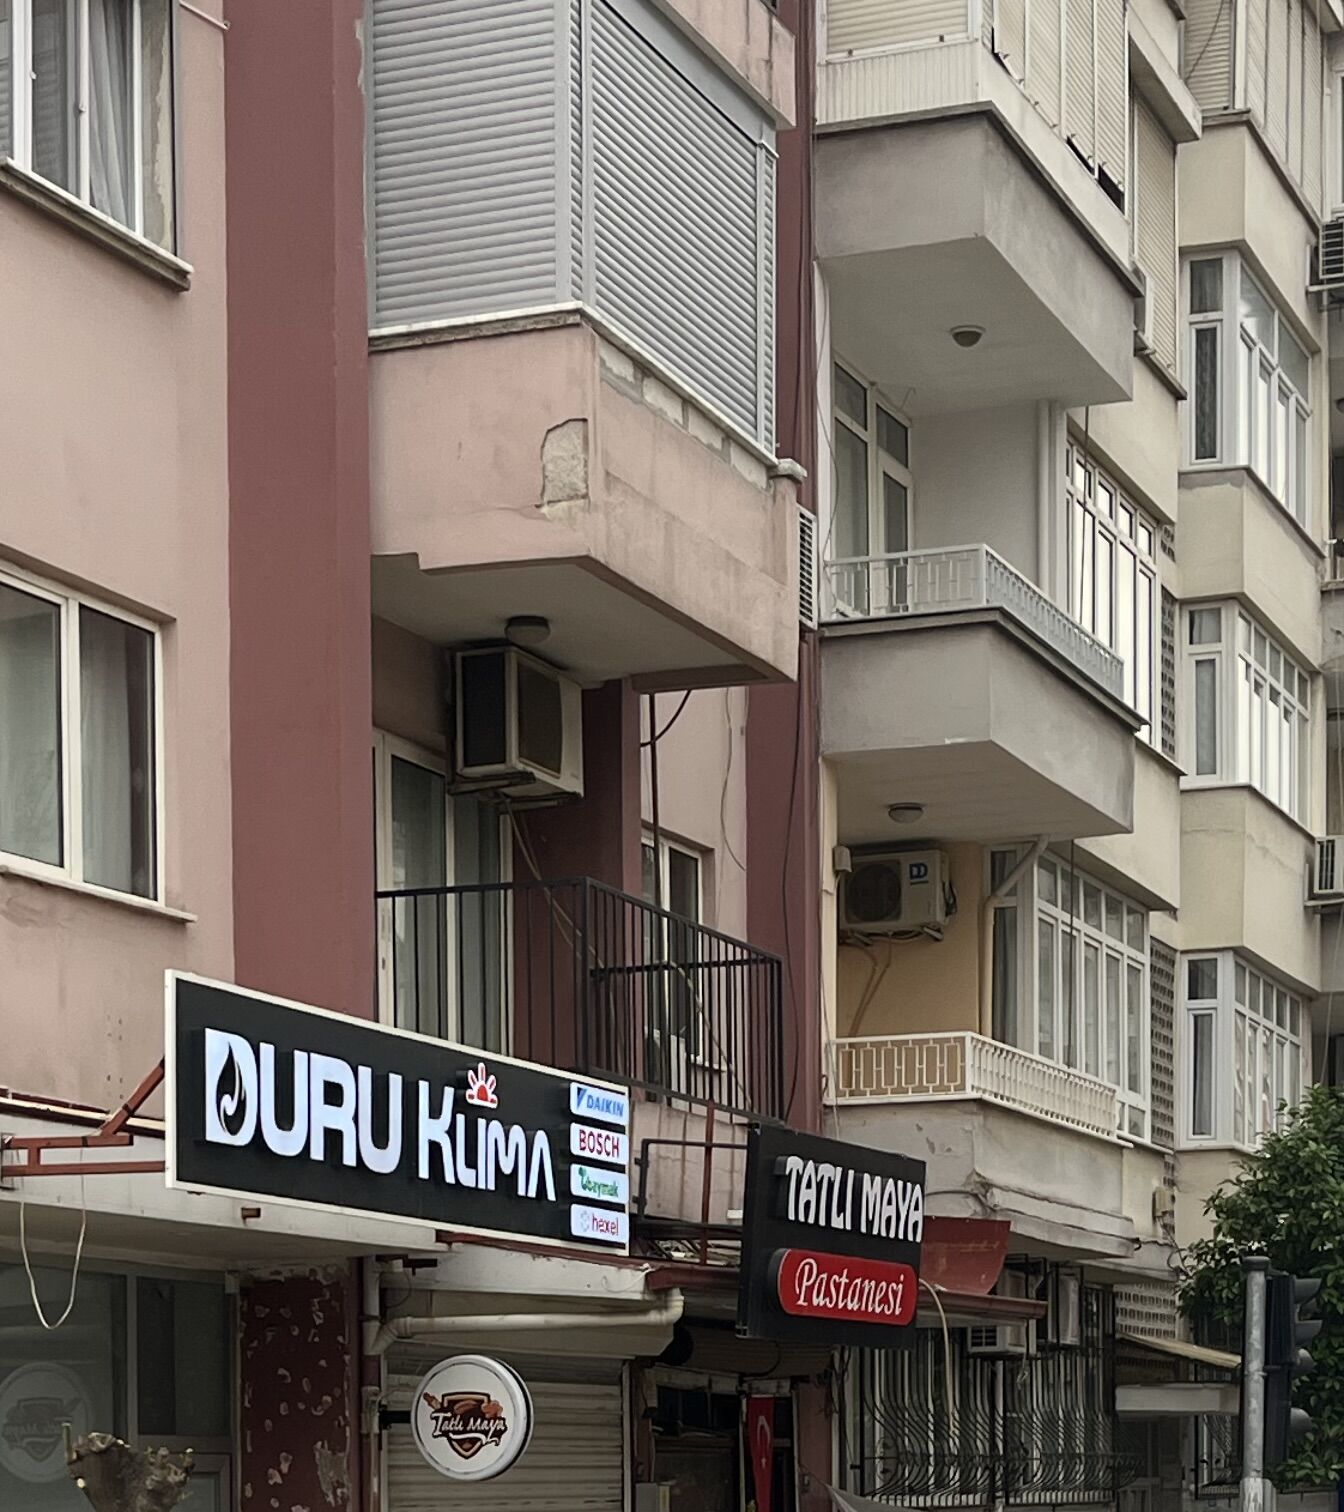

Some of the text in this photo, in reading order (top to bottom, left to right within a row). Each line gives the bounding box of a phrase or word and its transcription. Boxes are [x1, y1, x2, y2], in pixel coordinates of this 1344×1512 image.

[205, 1027, 402, 1173] DURU
[586, 1094, 624, 1117] DAIKIN
[579, 1129, 620, 1157] BOSCH
[586, 1178, 618, 1197] baymak
[786, 1156, 924, 1243] TATLI MAYA
[592, 1213, 619, 1236] hexel
[795, 1258, 904, 1315] Pastanesi
